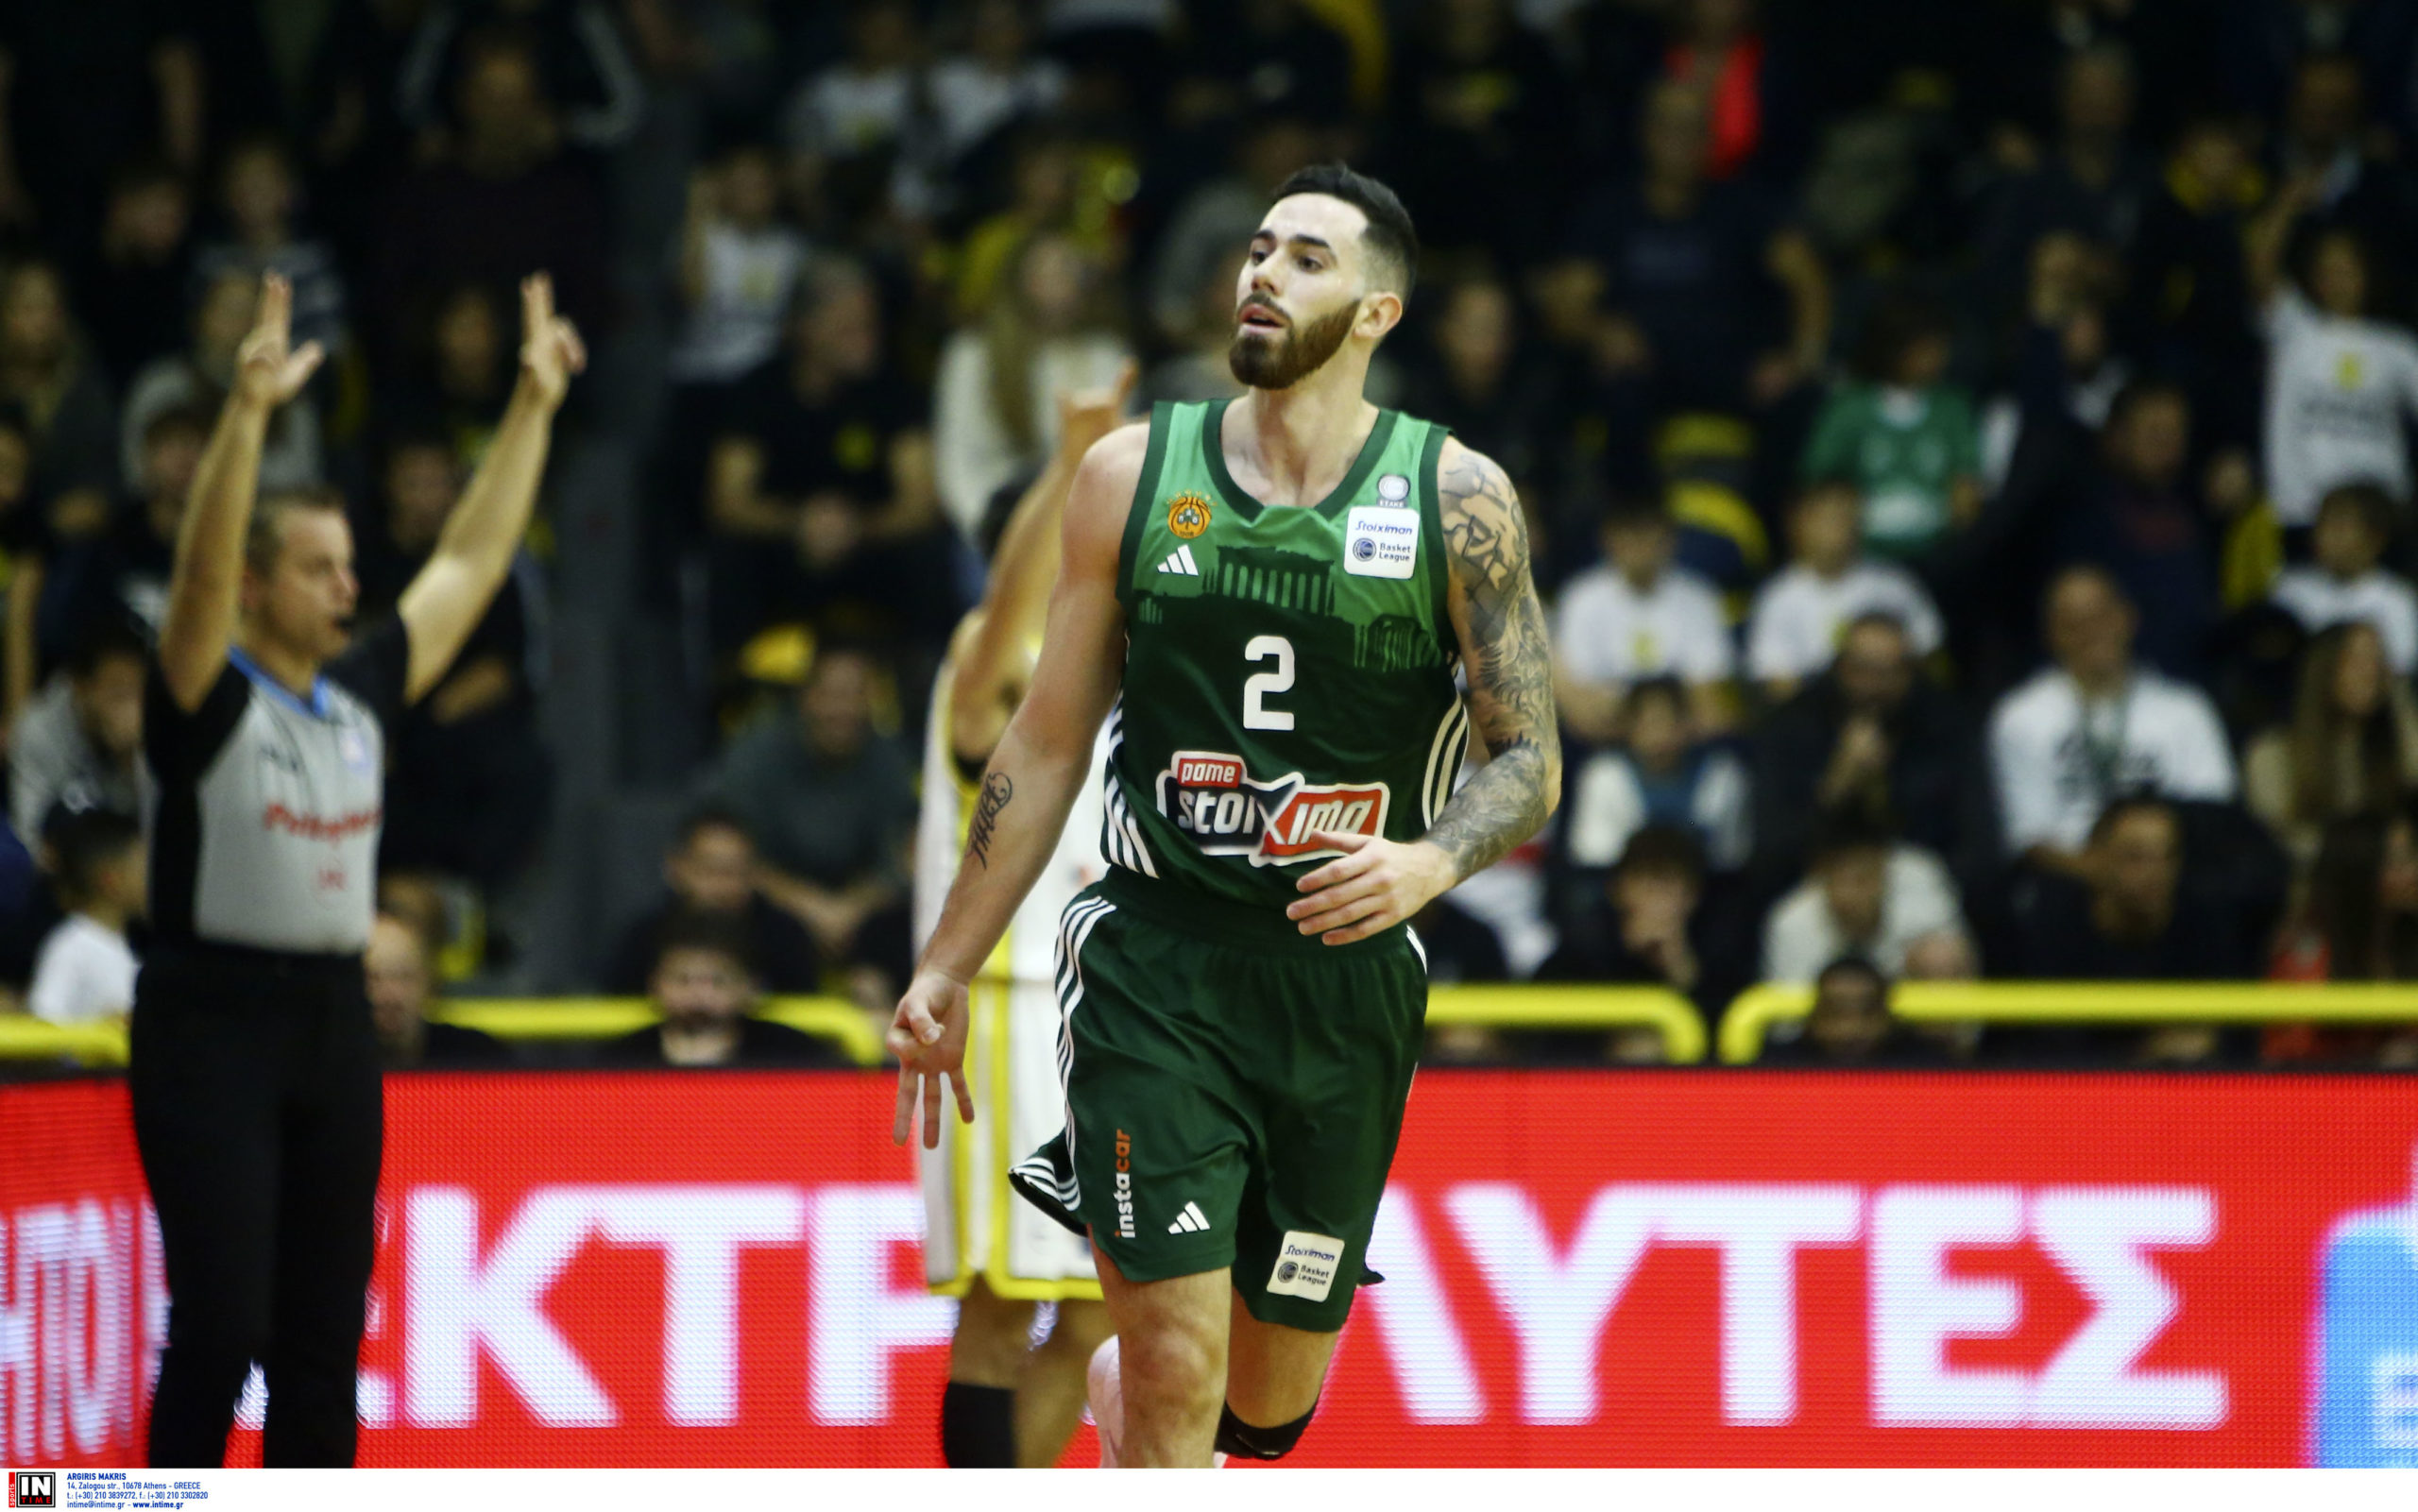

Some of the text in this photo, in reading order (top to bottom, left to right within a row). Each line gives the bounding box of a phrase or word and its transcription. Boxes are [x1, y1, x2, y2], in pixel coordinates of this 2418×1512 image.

[1380, 542, 1411, 553] Basket
[1379, 553, 1410, 563] League
[1243, 635, 1295, 731] 2
[1181, 762, 1237, 784] pame
[1114, 1128, 1136, 1239] instacar
[1298, 1273, 1326, 1285] League
[1301, 1265, 1330, 1279] Basket
